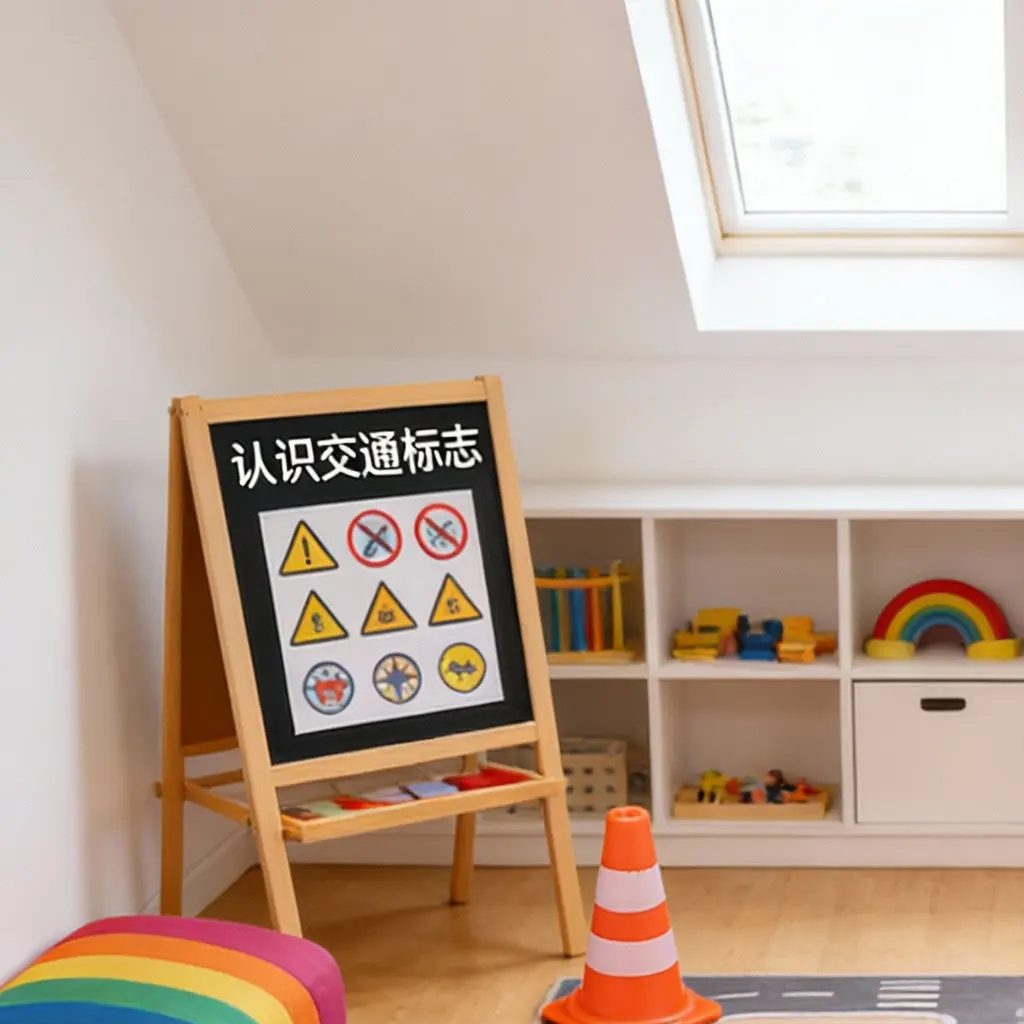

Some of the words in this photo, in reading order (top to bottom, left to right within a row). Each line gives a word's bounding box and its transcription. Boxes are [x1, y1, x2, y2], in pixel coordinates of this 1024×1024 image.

[231, 423, 483, 489] 认识交通标志
